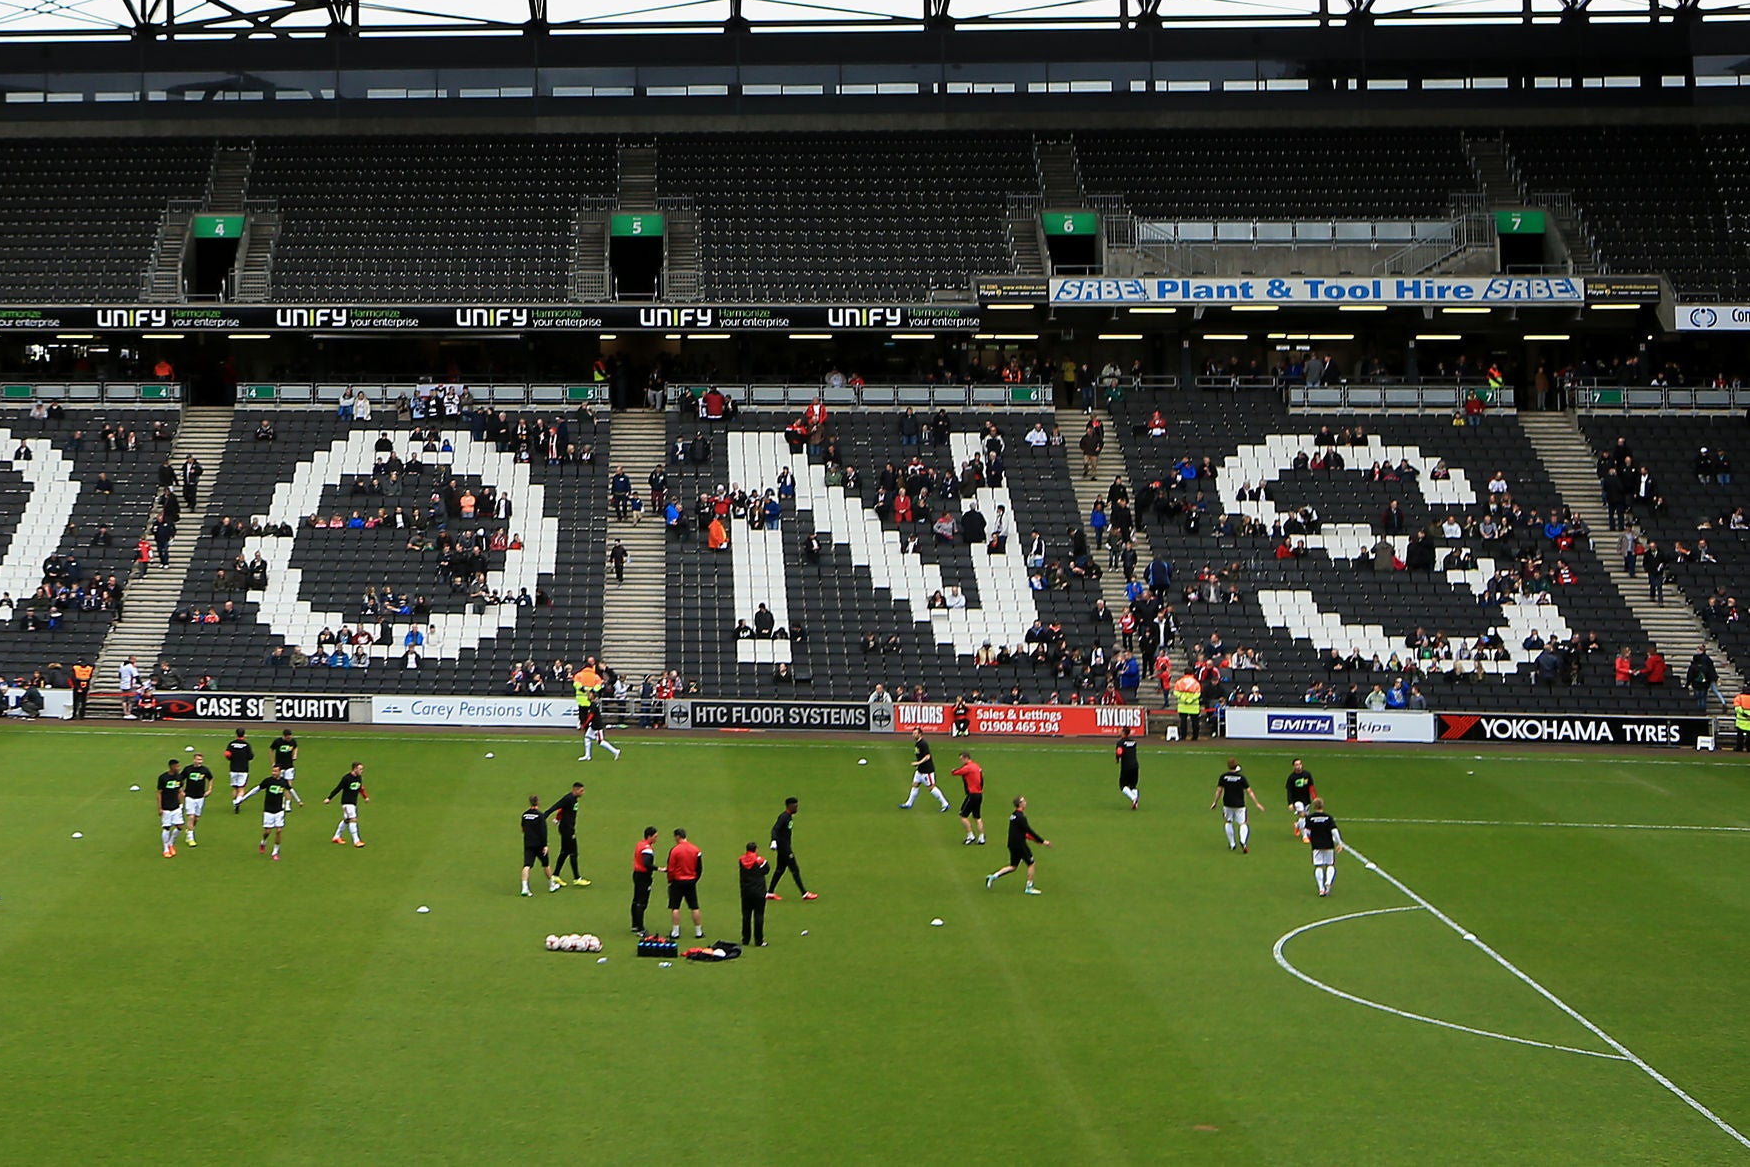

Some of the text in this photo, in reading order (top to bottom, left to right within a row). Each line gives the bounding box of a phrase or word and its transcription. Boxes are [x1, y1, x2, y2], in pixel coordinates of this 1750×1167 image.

[215, 223, 224, 236] 4
[632, 221, 642, 234] 5
[1063, 220, 1074, 233] 6
[1511, 218, 1521, 231] 7
[1157, 280, 1254, 299] Plant
[1266, 279, 1293, 299] &
[1303, 280, 1382, 299] Tool
[1396, 280, 1474, 299] Hire
[171, 310, 221, 318] Harmonize
[350, 310, 400, 318] Harmonize
[532, 310, 582, 318] Harmonize
[719, 310, 770, 318] Harmonize
[908, 310, 960, 318] Harmonize
[15, 318, 60, 328] enterprise
[172, 318, 240, 328] your enterprise
[350, 318, 419, 328] your enterprise
[532, 318, 602, 328] your enterprise
[719, 318, 789, 328] your enterprise
[909, 318, 980, 328] your enterprise
[159, 386, 166, 397] 4
[250, 386, 257, 397] 4
[587, 389, 594, 399] 5
[1030, 389, 1037, 401] 6
[1486, 392, 1492, 402] 7
[1593, 393, 1600, 404] 7
[195, 697, 242, 717] CASE
[411, 700, 554, 720] Carey Pensions UK
[695, 707, 727, 723] HTC
[732, 707, 784, 723] FLOOR
[789, 708, 866, 725] SYSTEMS
[898, 705, 944, 724] TAYLORS
[976, 709, 1062, 722] Sales & Lettings
[1095, 708, 1142, 726] TAYLORS
[979, 721, 1059, 732] 01908 465 194
[1270, 719, 1331, 731] SMITH
[1480, 718, 1681, 743] YOKOHAMA TYRES
